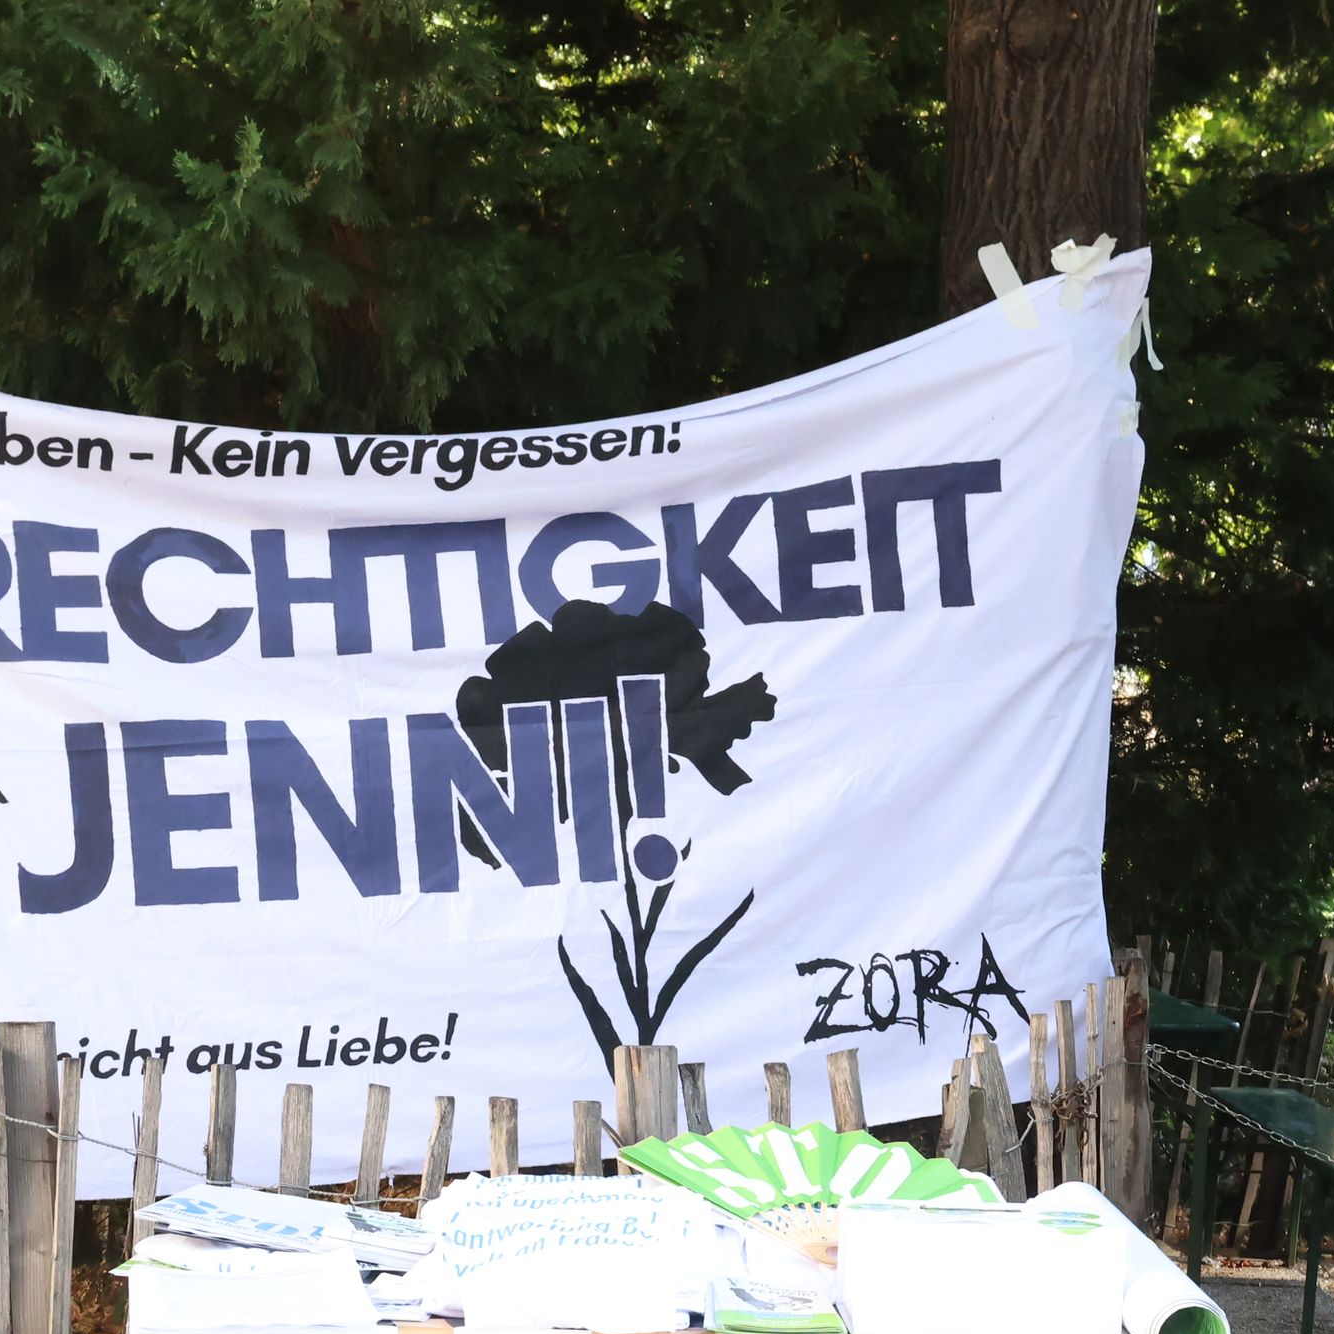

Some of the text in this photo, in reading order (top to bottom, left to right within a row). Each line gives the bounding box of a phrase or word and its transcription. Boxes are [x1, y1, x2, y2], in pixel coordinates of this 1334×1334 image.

[170, 424, 312, 479] Kein
[332, 419, 684, 491] Vergessen!
[18, 673, 678, 914] JENNI!
[186, 1040, 283, 1075] aus
[296, 1011, 460, 1069] Liebe!
[796, 933, 1030, 1058] ZORA
